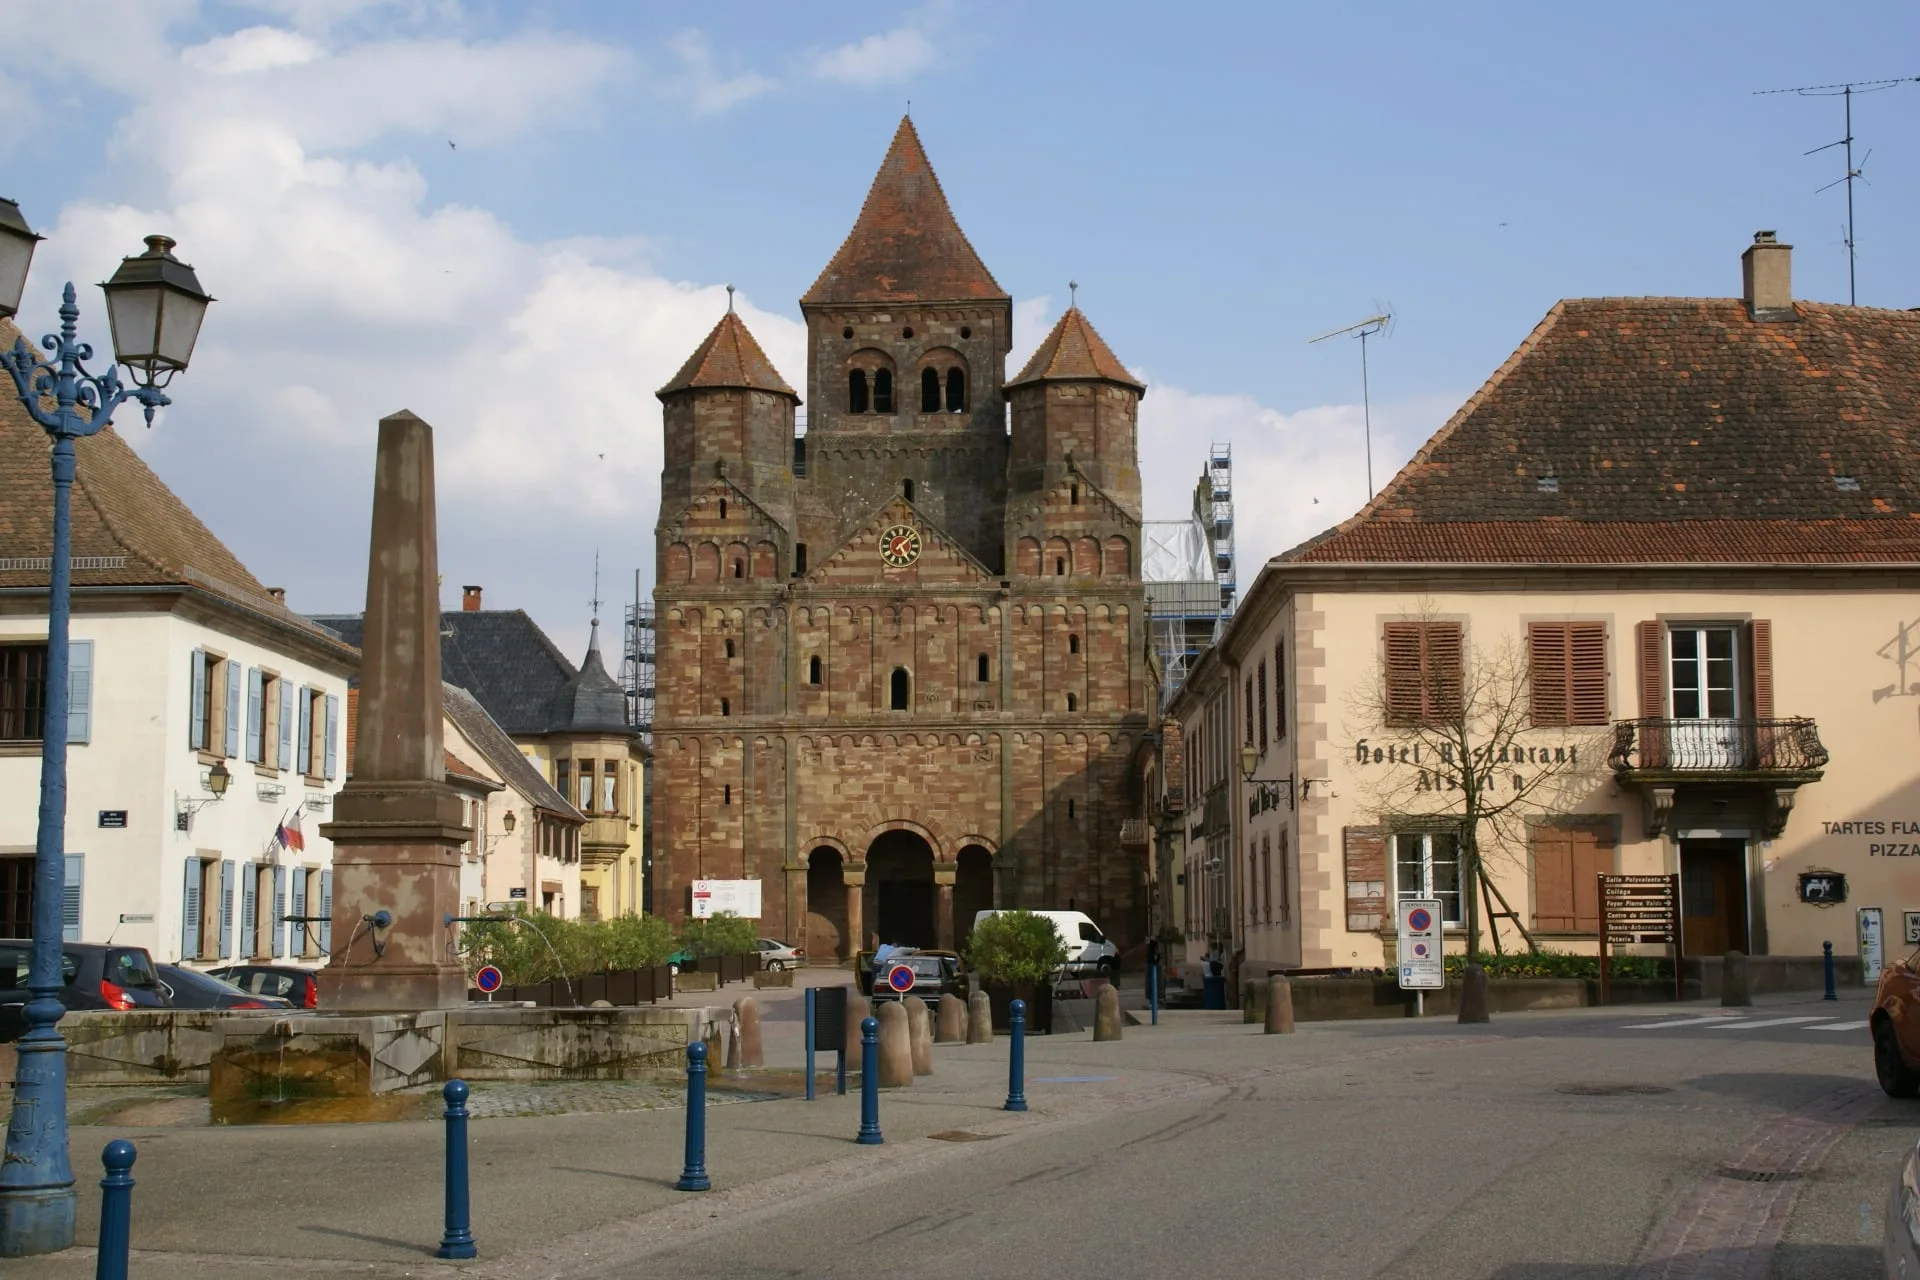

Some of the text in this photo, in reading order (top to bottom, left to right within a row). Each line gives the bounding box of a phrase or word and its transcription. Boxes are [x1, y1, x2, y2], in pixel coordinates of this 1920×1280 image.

[1356, 738, 1420, 765] Hotel
[1822, 821, 1885, 835] TARTES
[1625, 876, 1661, 884] Polyvalente
